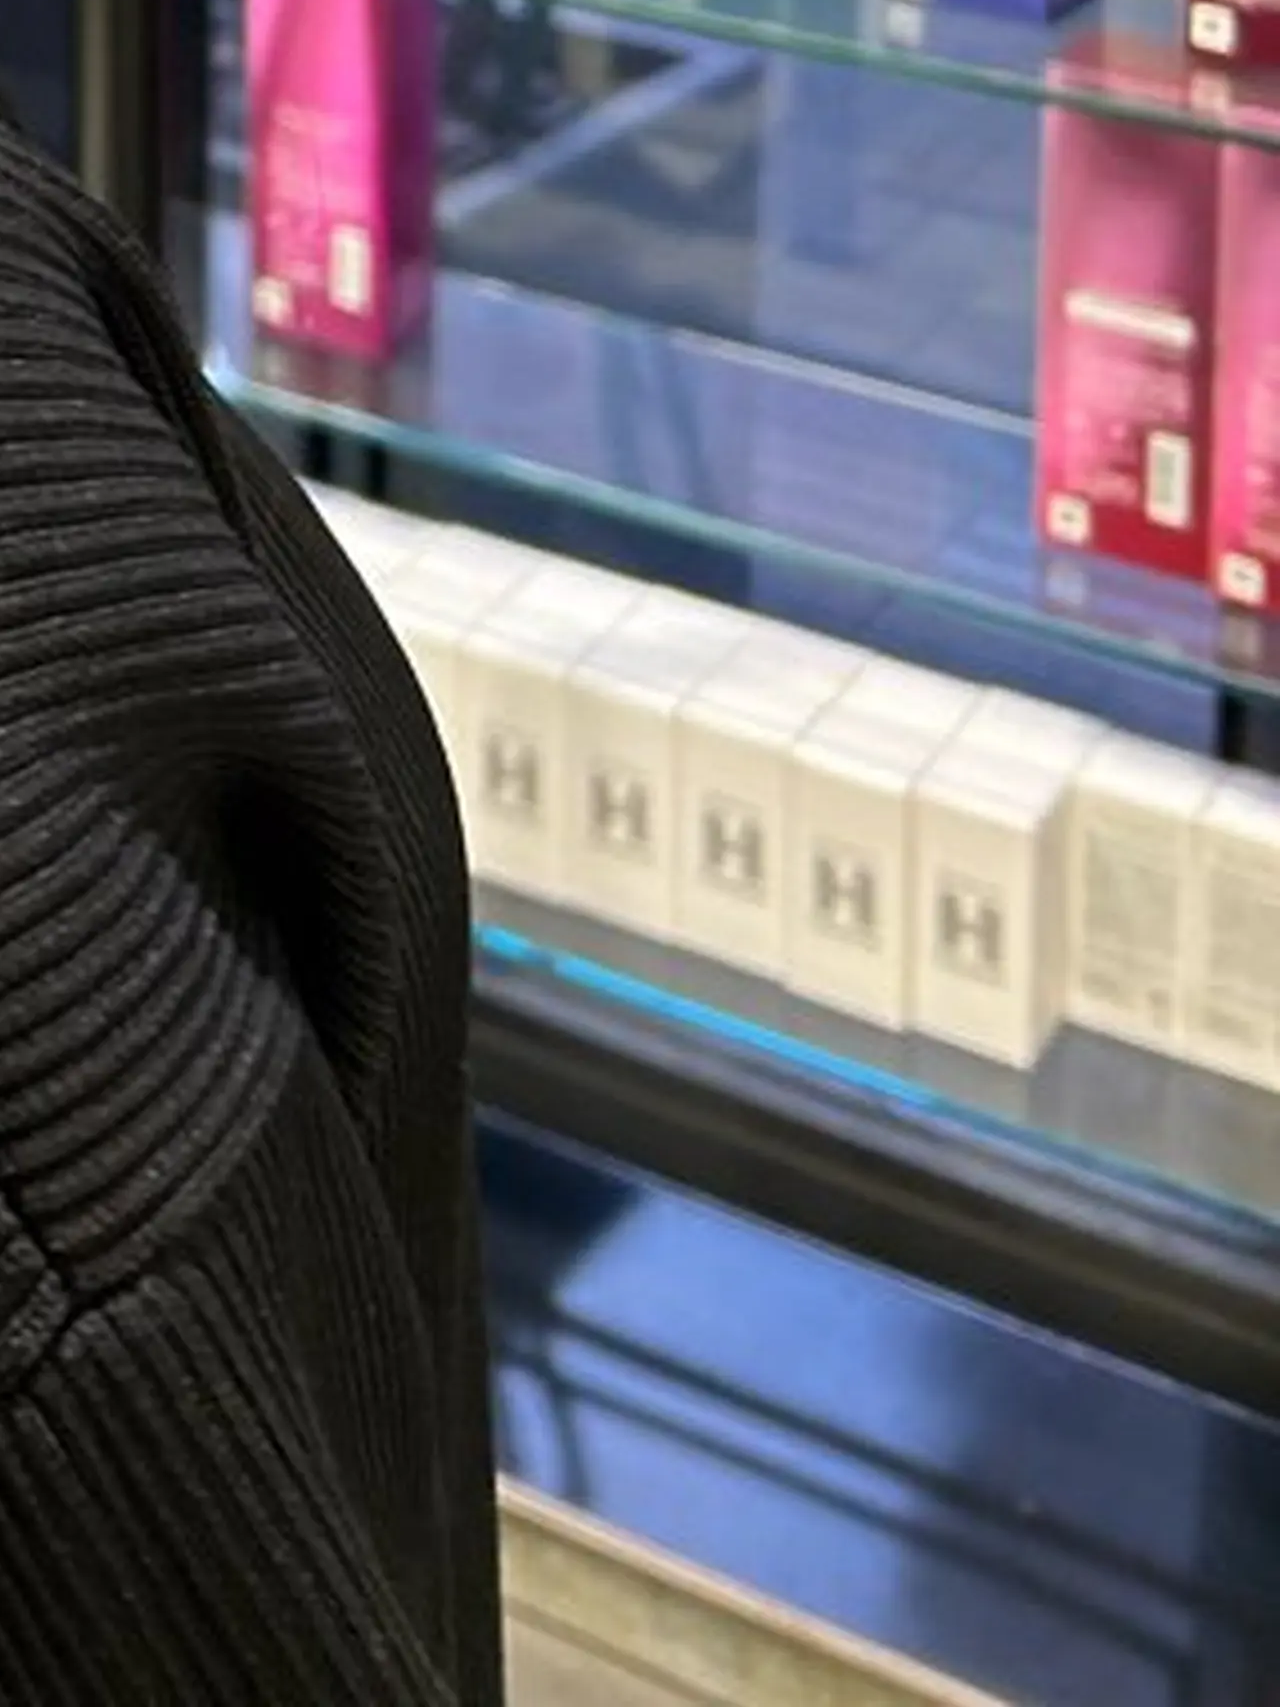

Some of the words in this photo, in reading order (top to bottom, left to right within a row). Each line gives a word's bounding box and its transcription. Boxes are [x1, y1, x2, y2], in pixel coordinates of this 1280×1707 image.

[487, 734, 541, 806] H
[590, 770, 649, 842] H
[702, 811, 763, 882] H
[816, 855, 877, 928] H
[939, 894, 1002, 965] H
